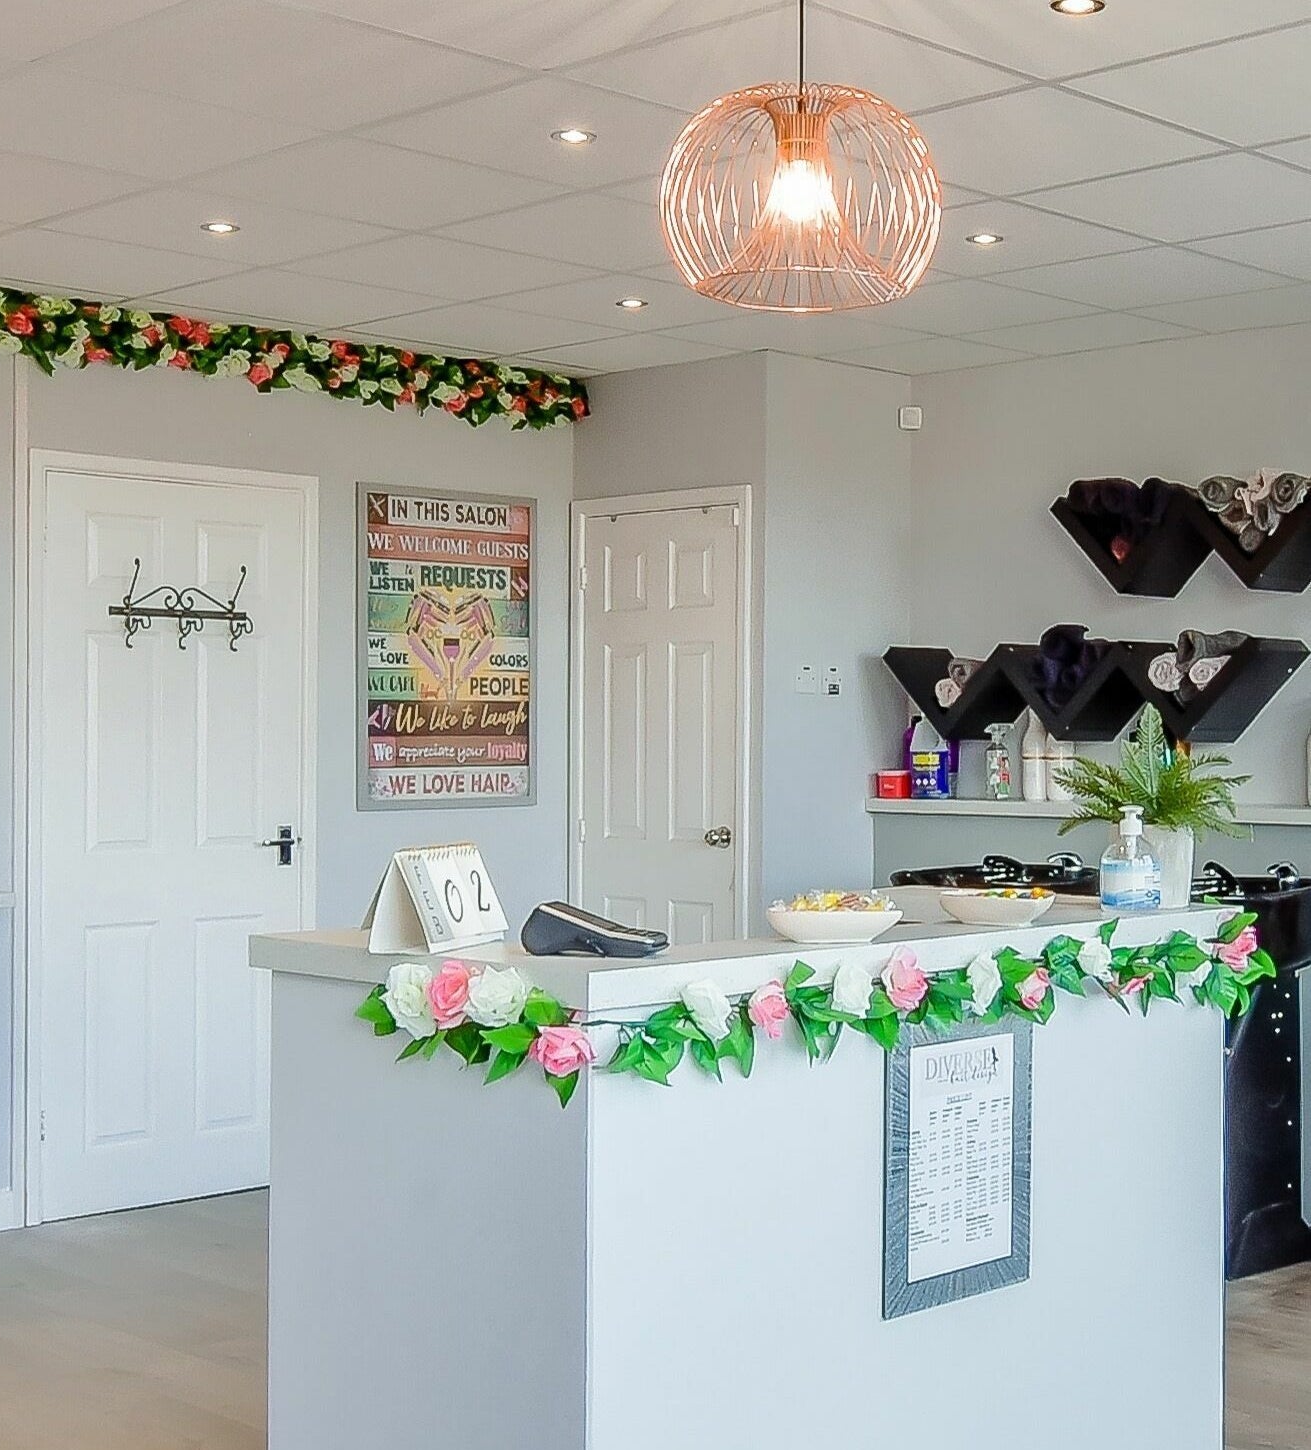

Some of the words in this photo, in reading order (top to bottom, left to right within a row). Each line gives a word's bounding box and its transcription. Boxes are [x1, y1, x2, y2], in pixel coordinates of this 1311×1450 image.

[391, 499, 408, 519] IN
[414, 501, 450, 523] THIS
[455, 504, 507, 527] SALON
[368, 532, 395, 551] WE
[399, 535, 473, 557] WELCOME
[477, 542, 529, 561] GUESTS
[369, 576, 415, 592] LISTEN
[420, 565, 507, 592] REQUESTS
[370, 561, 389, 575] WE
[369, 638, 387, 650] WE
[380, 652, 409, 665] LOVE
[489, 654, 529, 668] COLORS
[470, 677, 529, 696] PEOPLE
[396, 703, 426, 734] We
[430, 705, 459, 732] like
[462, 704, 478, 730] to
[481, 702, 527, 736] laugh
[372, 742, 394, 762] We
[398, 744, 456, 762] appreciate
[457, 747, 486, 764] your
[487, 742, 528, 762] loyalty
[389, 774, 416, 795] WE
[423, 774, 465, 794] LOVE
